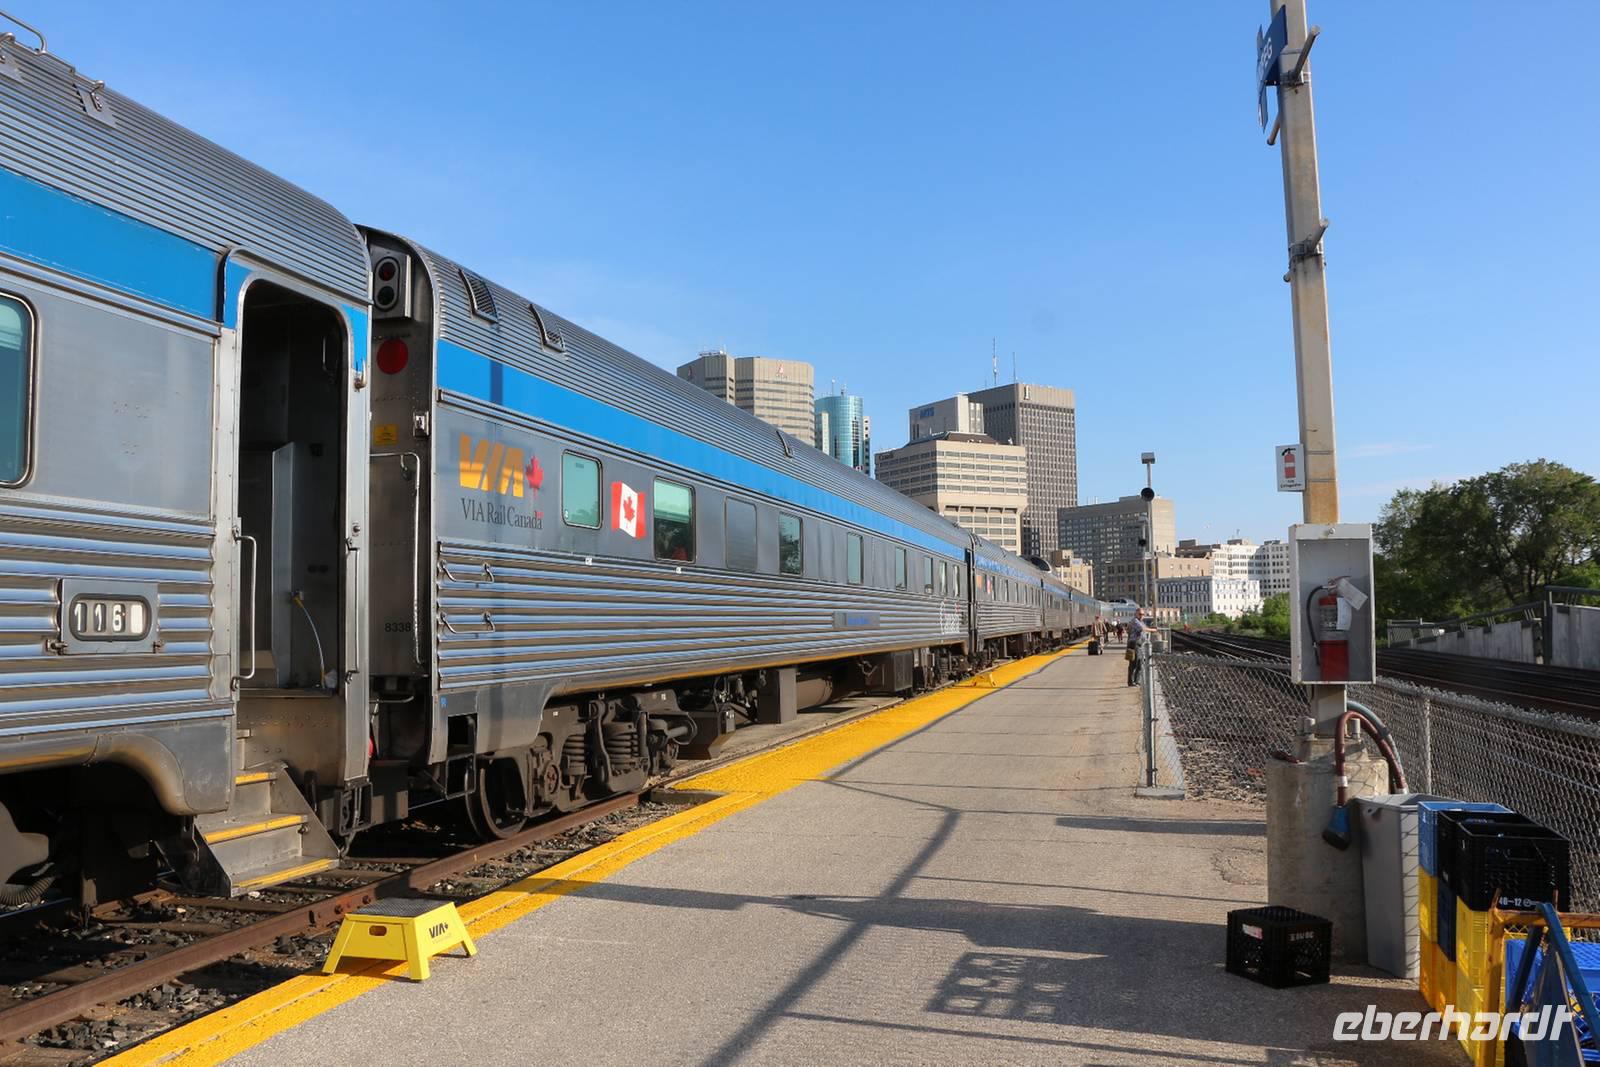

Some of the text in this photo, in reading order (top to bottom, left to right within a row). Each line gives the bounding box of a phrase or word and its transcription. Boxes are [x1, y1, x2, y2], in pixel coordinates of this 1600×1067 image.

[459, 432, 524, 497] VIA
[461, 498, 543, 530] VIA Rail Canada
[384, 622, 411, 633] 8338
[428, 922, 446, 939] VIA
